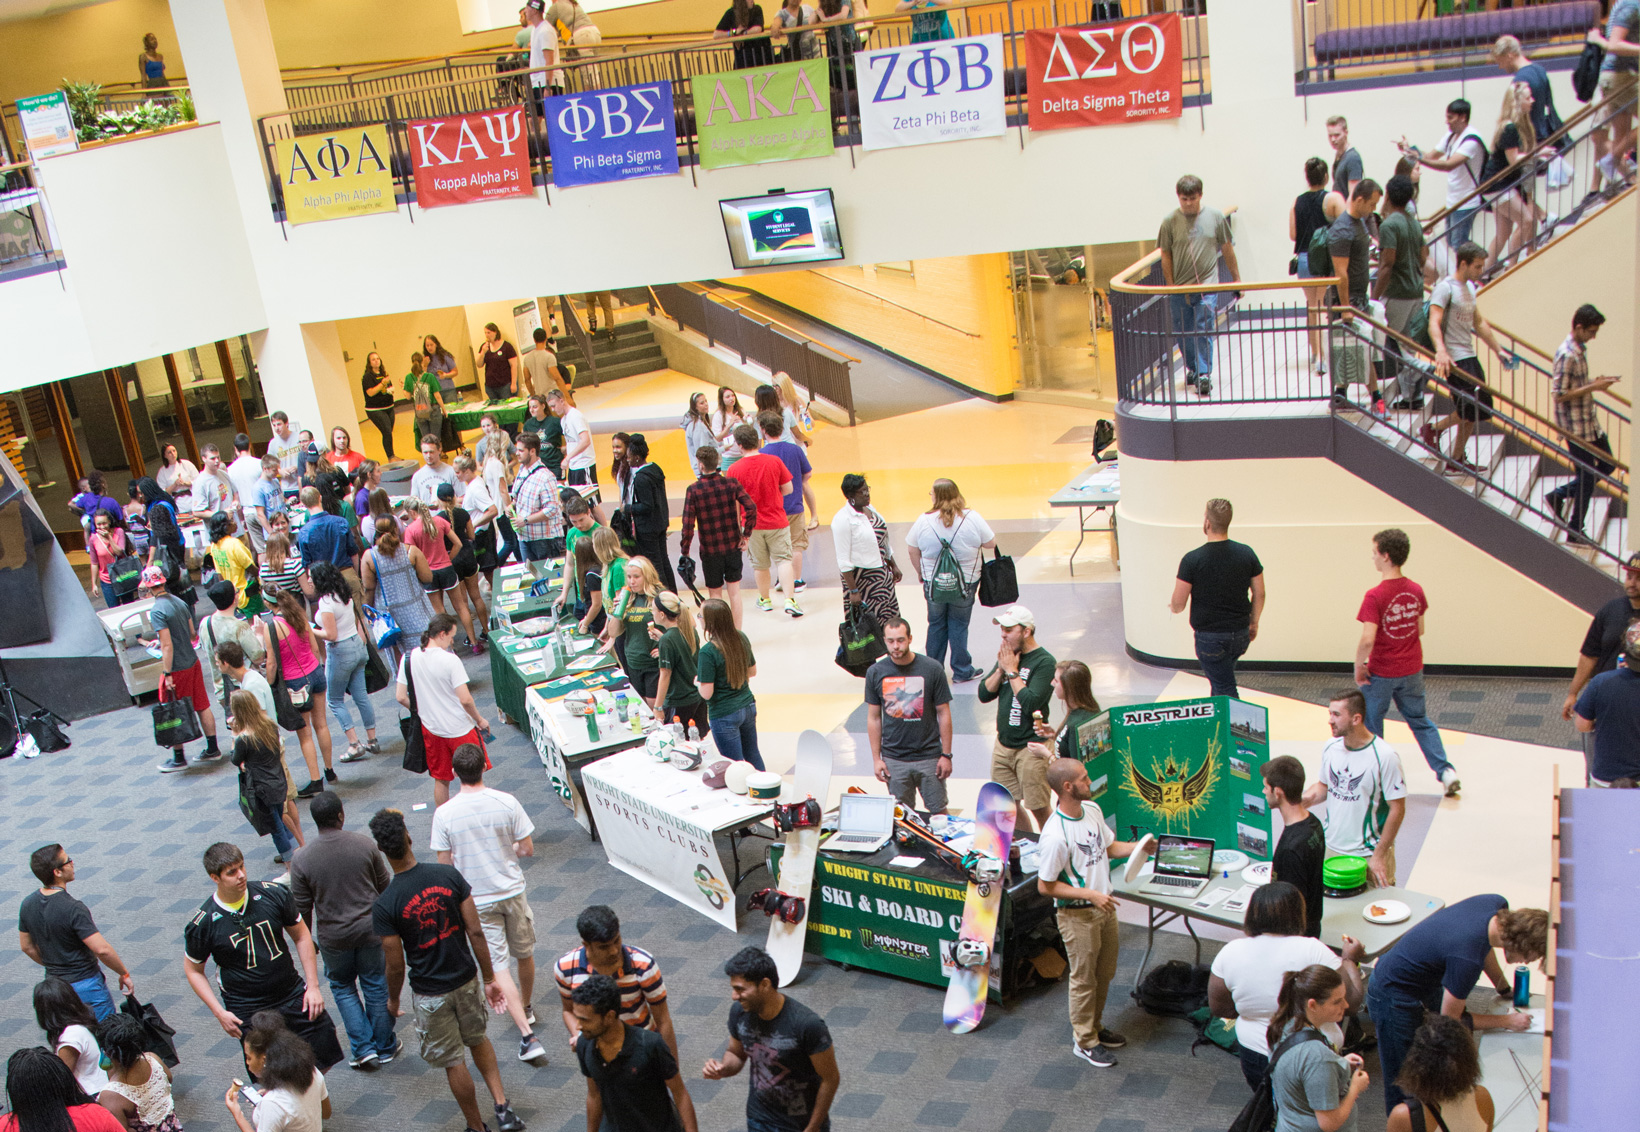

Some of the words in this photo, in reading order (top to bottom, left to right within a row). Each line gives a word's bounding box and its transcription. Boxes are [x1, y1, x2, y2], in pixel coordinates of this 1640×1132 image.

[1042, 97, 1079, 113] Delta
[1083, 94, 1125, 112] Sigma
[1129, 89, 1170, 105] Theta
[1126, 108, 1157, 117] SORORITY,
[1158, 106, 1170, 114] INC.
[893, 116, 921, 130] Zeta
[926, 111, 946, 126] Phi
[950, 109, 979, 123] Beta
[711, 137, 745, 152] Alpha
[749, 133, 787, 148] Kappa
[791, 127, 827, 143] Alpha
[573, 155, 595, 170] Phi
[597, 153, 624, 167] Beta
[626, 150, 662, 166] Sigma
[622, 165, 653, 175] FRATERNITY,
[434, 178, 467, 192] Kappa
[470, 172, 501, 187] Alpha
[503, 168, 519, 181] Psi
[303, 194, 332, 209] Alpha
[334, 191, 350, 204] Phi
[353, 187, 382, 202] Alpha
[1008, 708, 1022, 727] CLUB
[1124, 704, 1213, 726] AIRSTRIKE
[583, 772, 620, 800] WRIGHT
[621, 792, 650, 816] STATE
[650, 805, 713, 843] UNIVERSITY
[595, 793, 650, 830] SPORTS
[657, 825, 710, 858] CLUBS
[823, 860, 870, 883] WRIGHT
[872, 872, 912, 891] STATE
[914, 881, 968, 902] UNIVERS
[821, 885, 854, 909] SKI
[858, 894, 872, 913] &
[875, 897, 944, 929] BOARD
[807, 921, 838, 937] SORED
[839, 928, 853, 939] BY
[229, 919, 284, 970] 71
[874, 932, 930, 956] MONSTER
[882, 945, 921, 960] ENERGY
